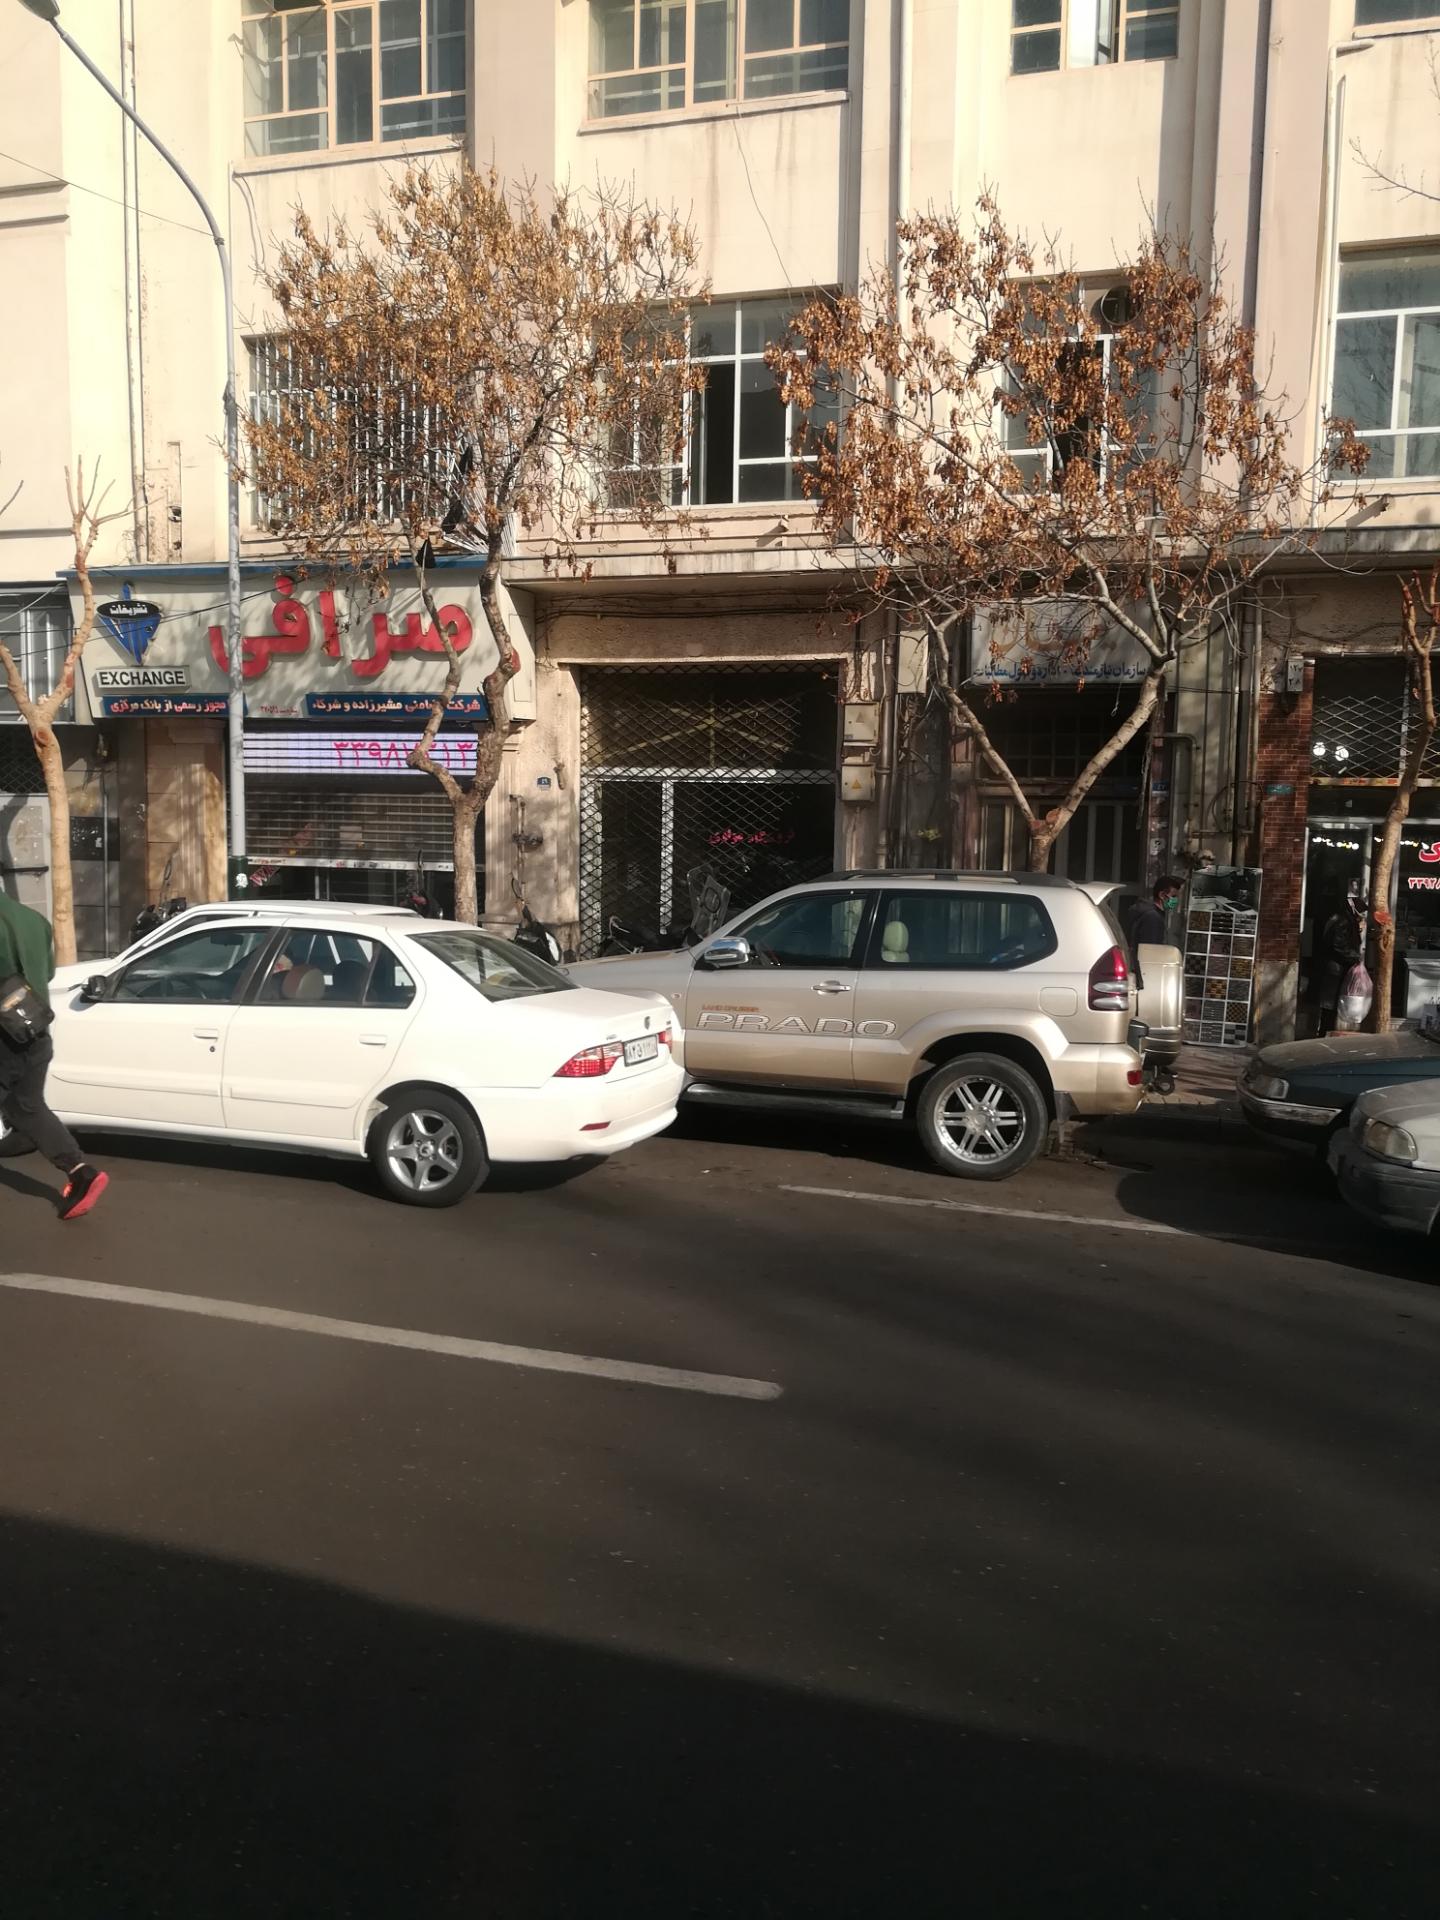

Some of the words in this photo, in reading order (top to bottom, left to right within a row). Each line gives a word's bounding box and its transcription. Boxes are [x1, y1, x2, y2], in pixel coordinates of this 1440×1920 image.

[109, 603, 148, 617] تشریفات
[208, 575, 474, 679] صرافی
[100, 671, 186, 686] EXCHANGE
[110, 698, 139, 713] مرکزی
[141, 699, 162, 713] بانک
[163, 699, 173, 713] از
[174, 701, 202, 713] رسمی
[203, 699, 227, 713] مجوز
[446, 699, 481, 713] شرکت
[696, 1011, 898, 1038] PRADO
